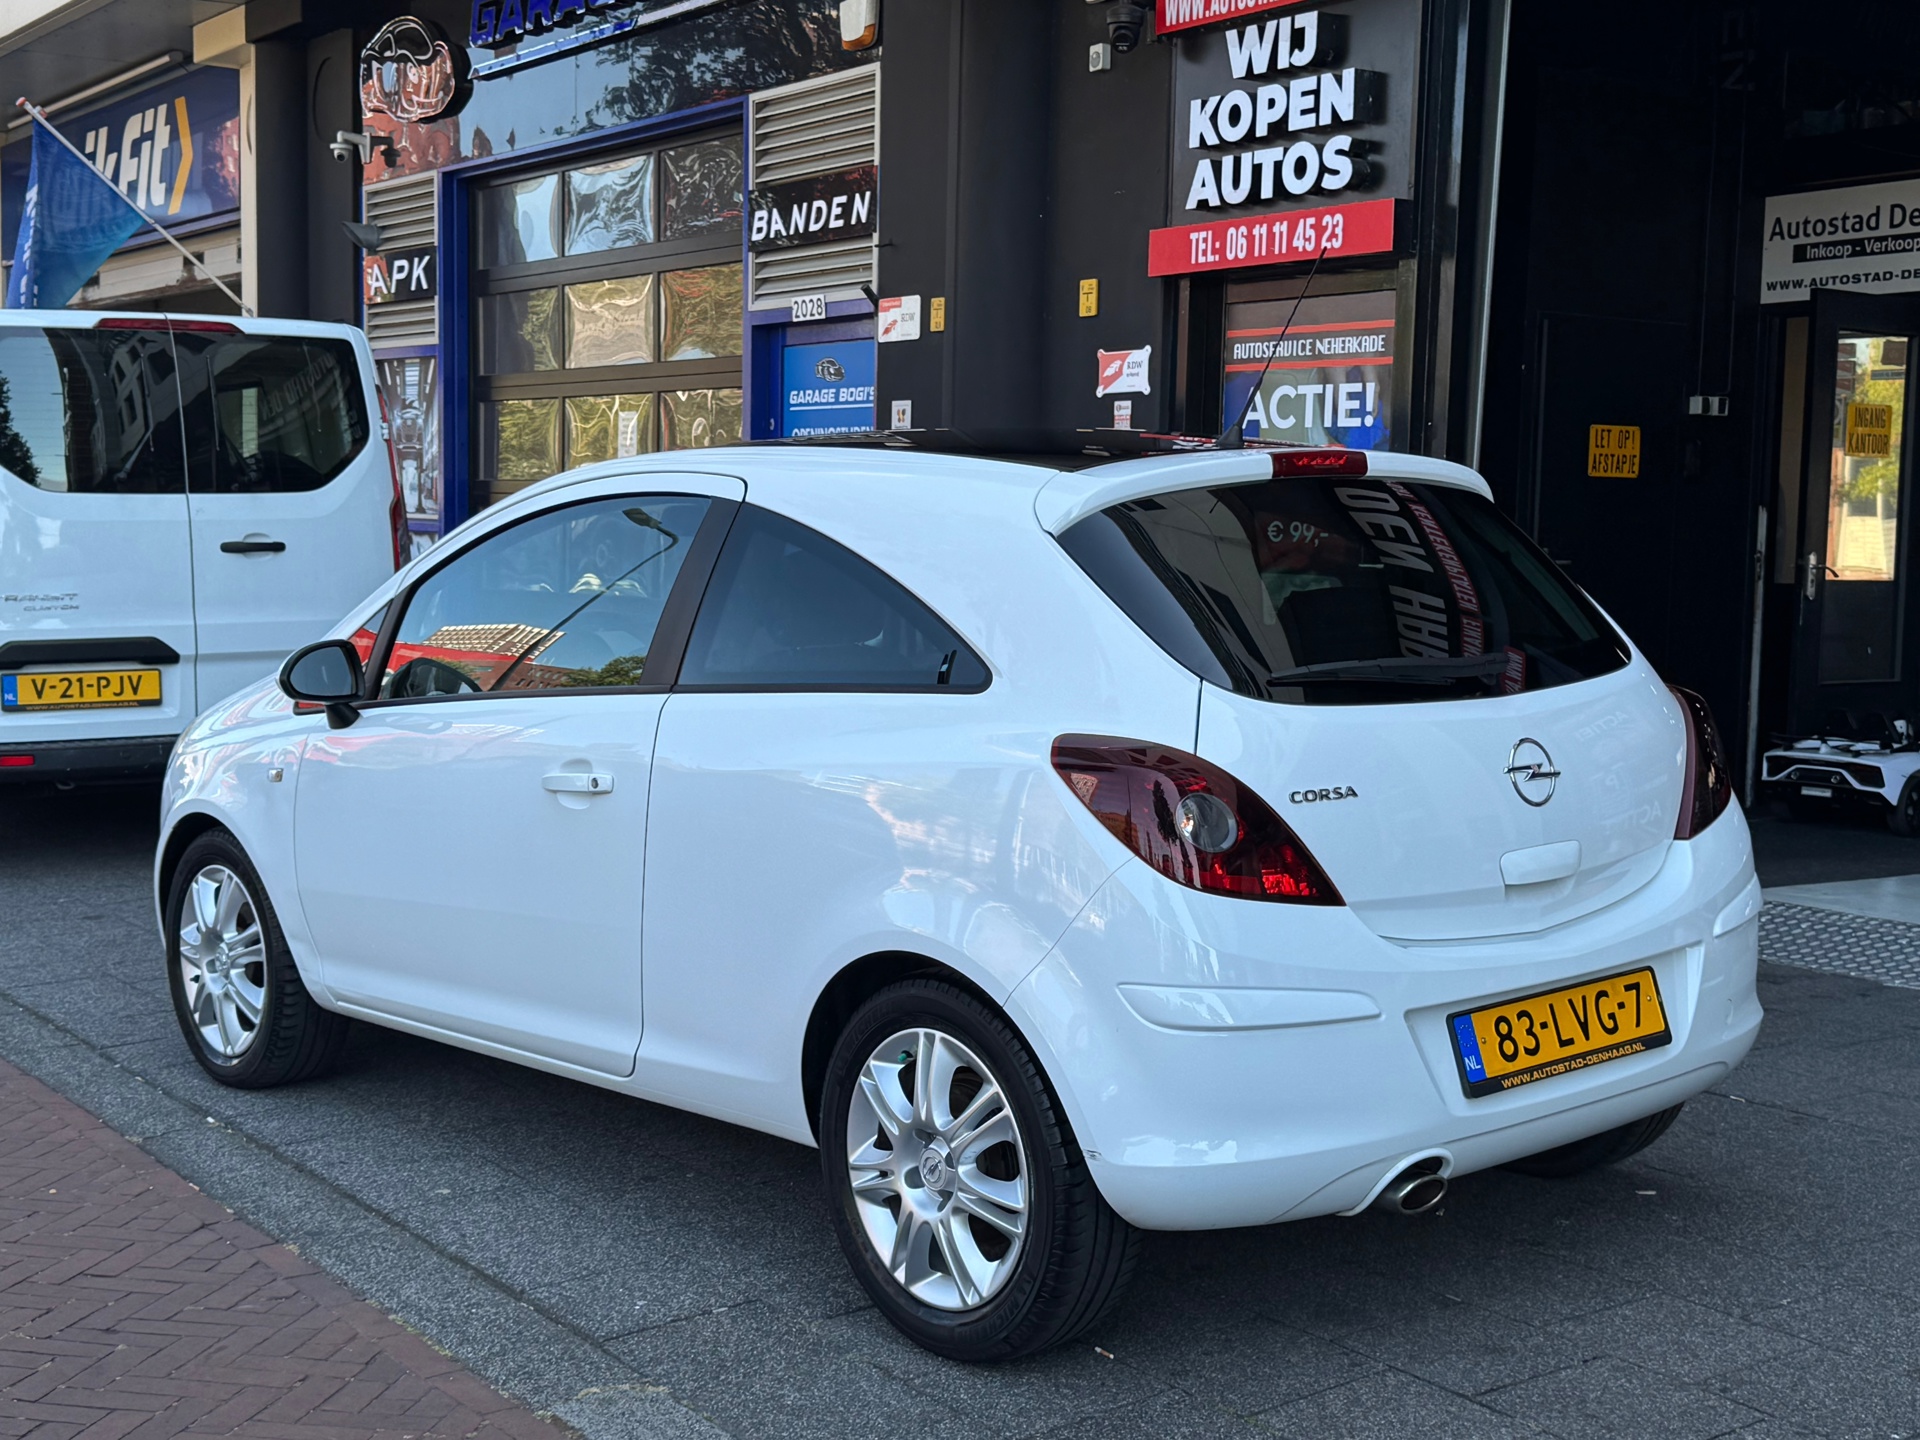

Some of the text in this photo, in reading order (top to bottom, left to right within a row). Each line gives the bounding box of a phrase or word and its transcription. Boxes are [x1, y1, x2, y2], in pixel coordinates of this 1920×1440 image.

[1225, 10, 1318, 79] WIJ
[1188, 67, 1356, 149] KOPEN
[1185, 134, 1353, 210] AUTOS
[751, 190, 871, 242] BANDEN
[1768, 205, 1881, 242] Autostad
[1189, 212, 1344, 264] TEL: 06 11 11 45 23
[1806, 244, 1852, 260] Inkoop
[1864, 237, 1920, 255] Verkoop
[370, 255, 431, 296] APK
[793, 297, 824, 319] 2028
[1315, 334, 1386, 356] NEHERKADE
[789, 388, 836, 404] GARAGE
[1242, 382, 1376, 430] ACTIE!
[1854, 406, 1886, 429] INGANG
[1595, 428, 1635, 450] LET OP!
[1848, 431, 1890, 455] KANTOOR
[1591, 453, 1637, 474] AFSTAPJE
[1267, 521, 1284, 543] €
[4, 692, 16, 701] NL
[31, 674, 143, 700] V-21-PJV
[1288, 785, 1359, 805] CORSA
[1493, 981, 1641, 1063] 83-LVG-7
[1464, 1055, 1481, 1071] NL
[1501, 1042, 1646, 1089] WWW.AUTOSTAD-DENHAAG.NL
